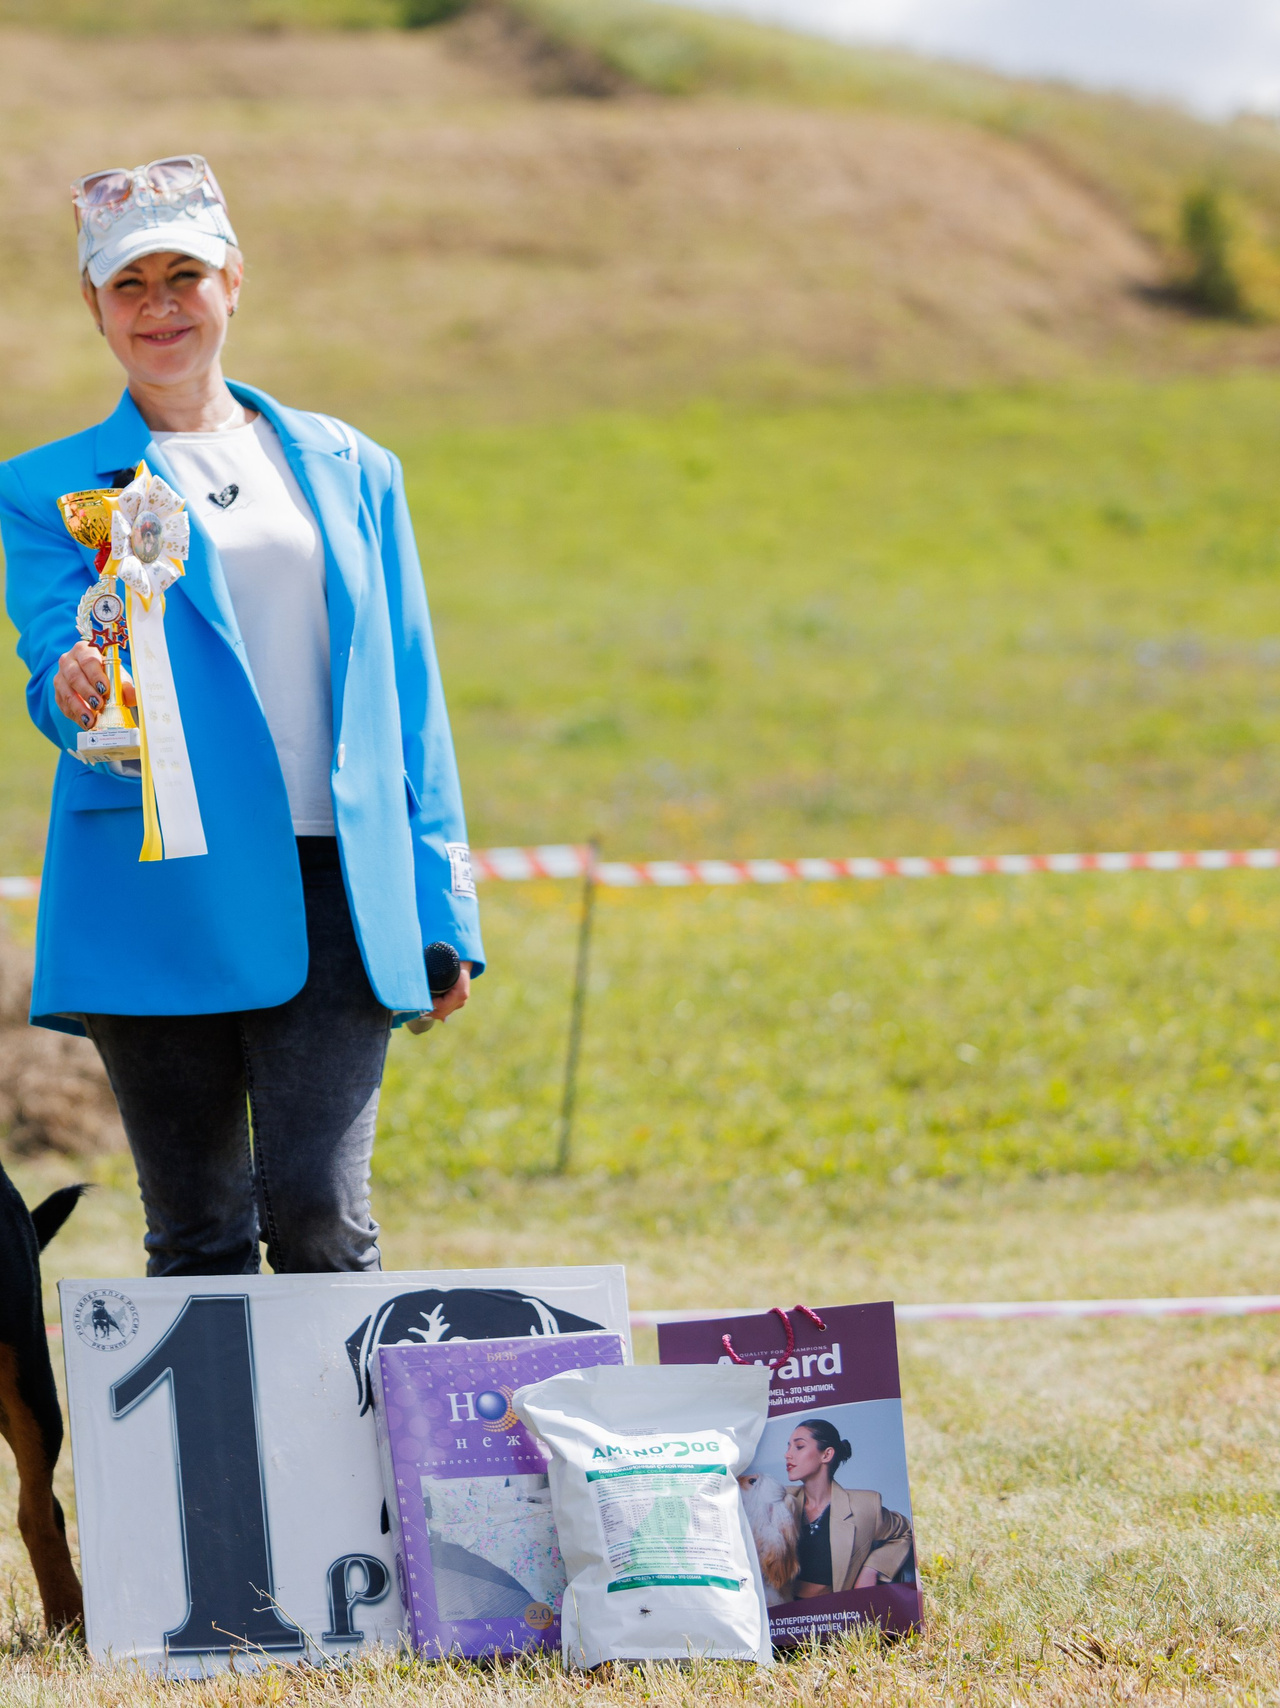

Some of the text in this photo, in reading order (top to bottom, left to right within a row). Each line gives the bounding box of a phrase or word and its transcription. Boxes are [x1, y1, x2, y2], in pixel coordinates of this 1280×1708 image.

[102, 1290, 125, 1301] КЛУБ
[787, 1345, 828, 1353] HAMPIONS
[486, 1352, 518, 1362] БЯЗЬ
[789, 1386, 802, 1395] ЭТО
[802, 1383, 835, 1393] ЧЕМПИОН,
[416, 1457, 478, 1467] комплект
[109, 1293, 306, 1653] 1
[528, 1607, 551, 1621] 2,0
[775, 1613, 832, 1626] СУПЕРПРЕМИУМ
[832, 1610, 860, 1620] КЛАССА
[770, 1628, 786, 1637] ДЛЯ
[786, 1626, 809, 1635] СОБАК
